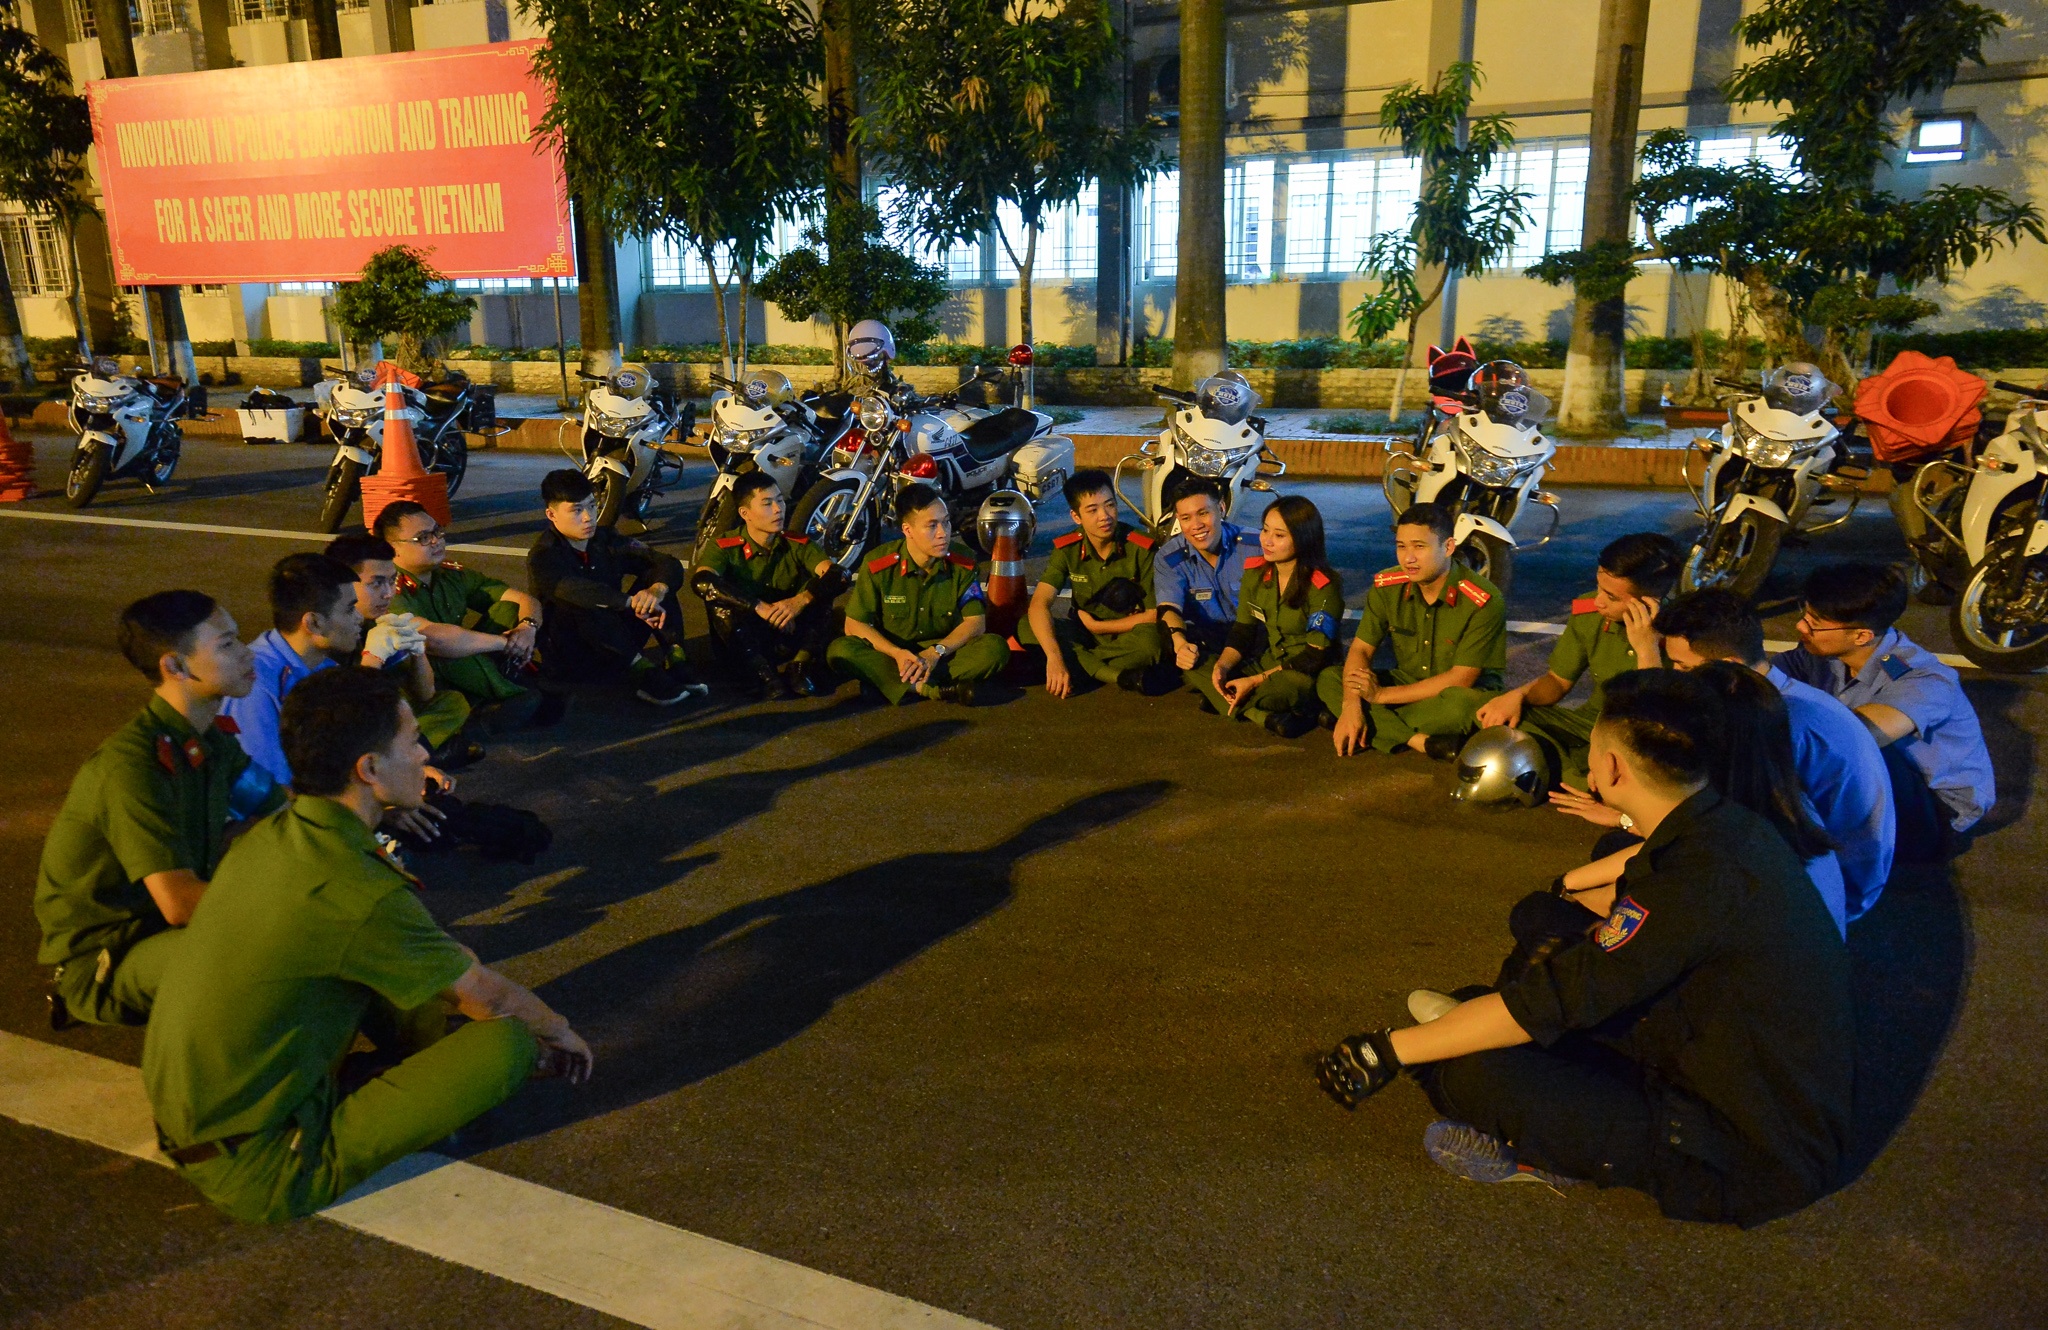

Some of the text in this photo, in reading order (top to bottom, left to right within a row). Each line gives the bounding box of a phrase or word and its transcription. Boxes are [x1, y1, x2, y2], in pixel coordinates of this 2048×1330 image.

[115, 91, 531, 168] INNOVATION IN POLICE EDUCATION AND TRAINING
[154, 182, 505, 244] FOR A SAFER AND MORE SECURE VIETNAM
